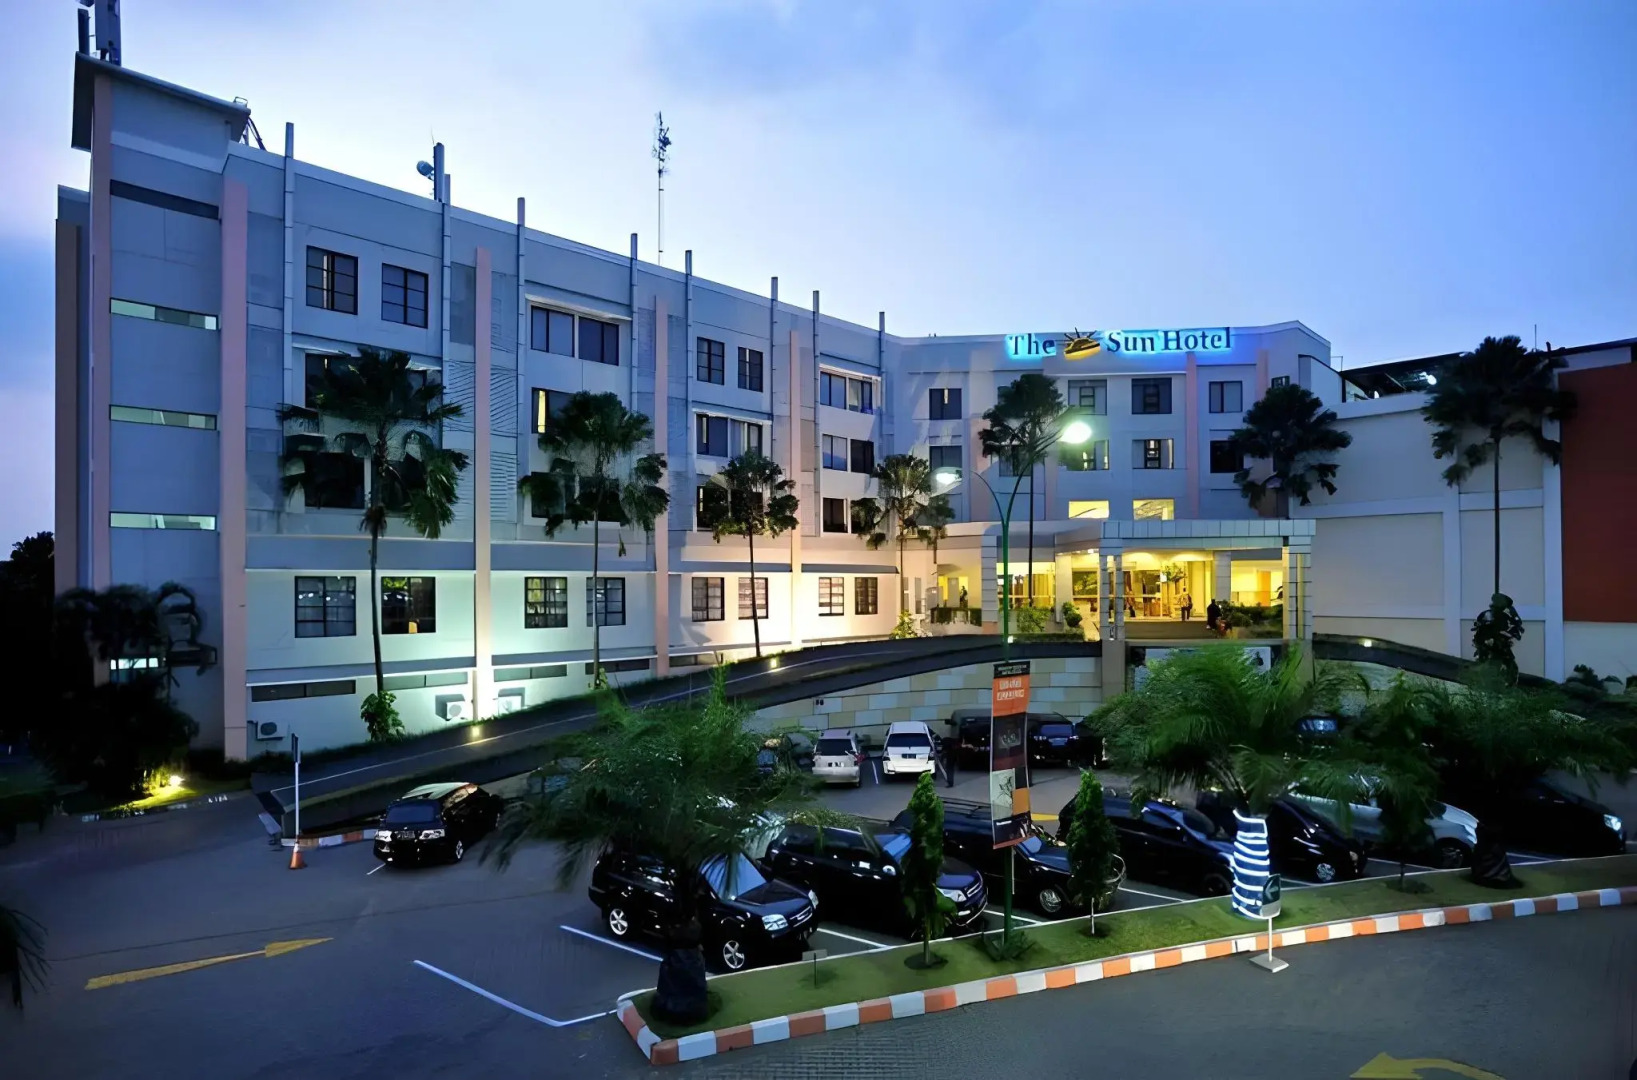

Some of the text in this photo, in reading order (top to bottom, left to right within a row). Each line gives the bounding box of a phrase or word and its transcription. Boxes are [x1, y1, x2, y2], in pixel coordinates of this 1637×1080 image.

[1008, 326, 1232, 356] The Sun Hotel
